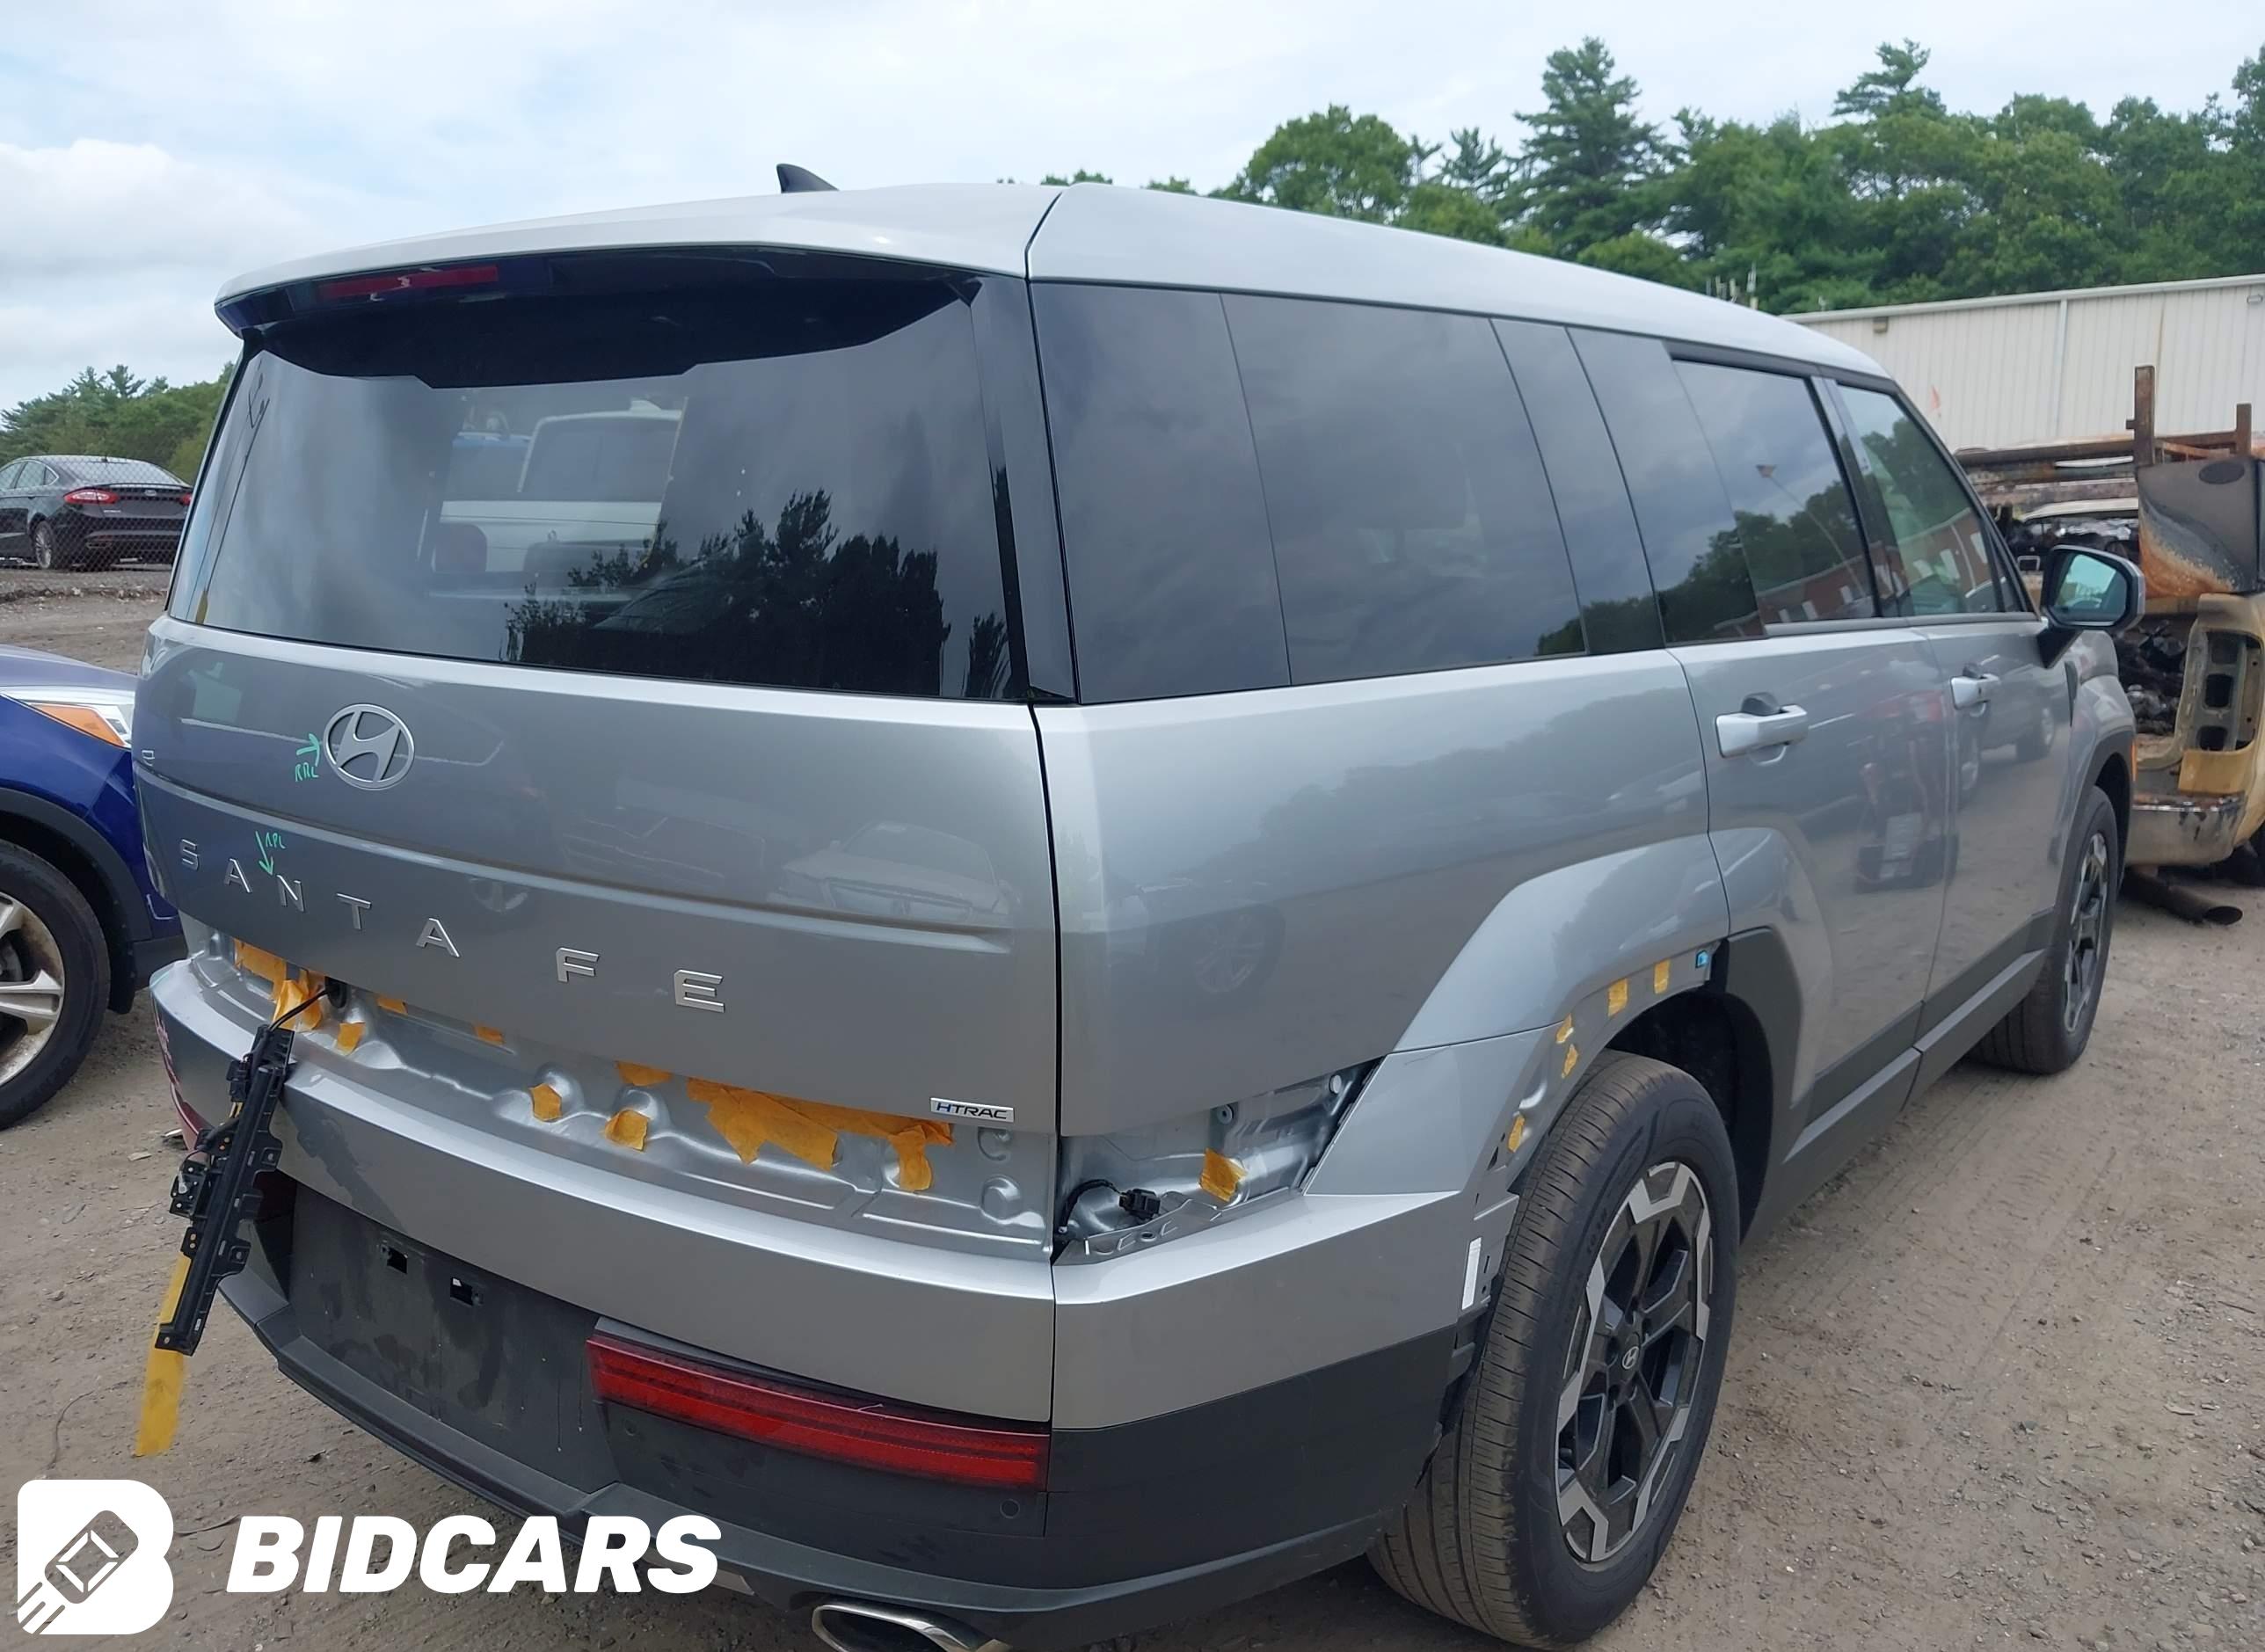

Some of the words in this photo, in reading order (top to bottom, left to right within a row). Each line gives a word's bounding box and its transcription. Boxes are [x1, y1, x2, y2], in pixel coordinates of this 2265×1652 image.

[179, 838, 461, 958] SANTA
[556, 947, 726, 1014] FE
[936, 1102, 1008, 1120] HTRAC
